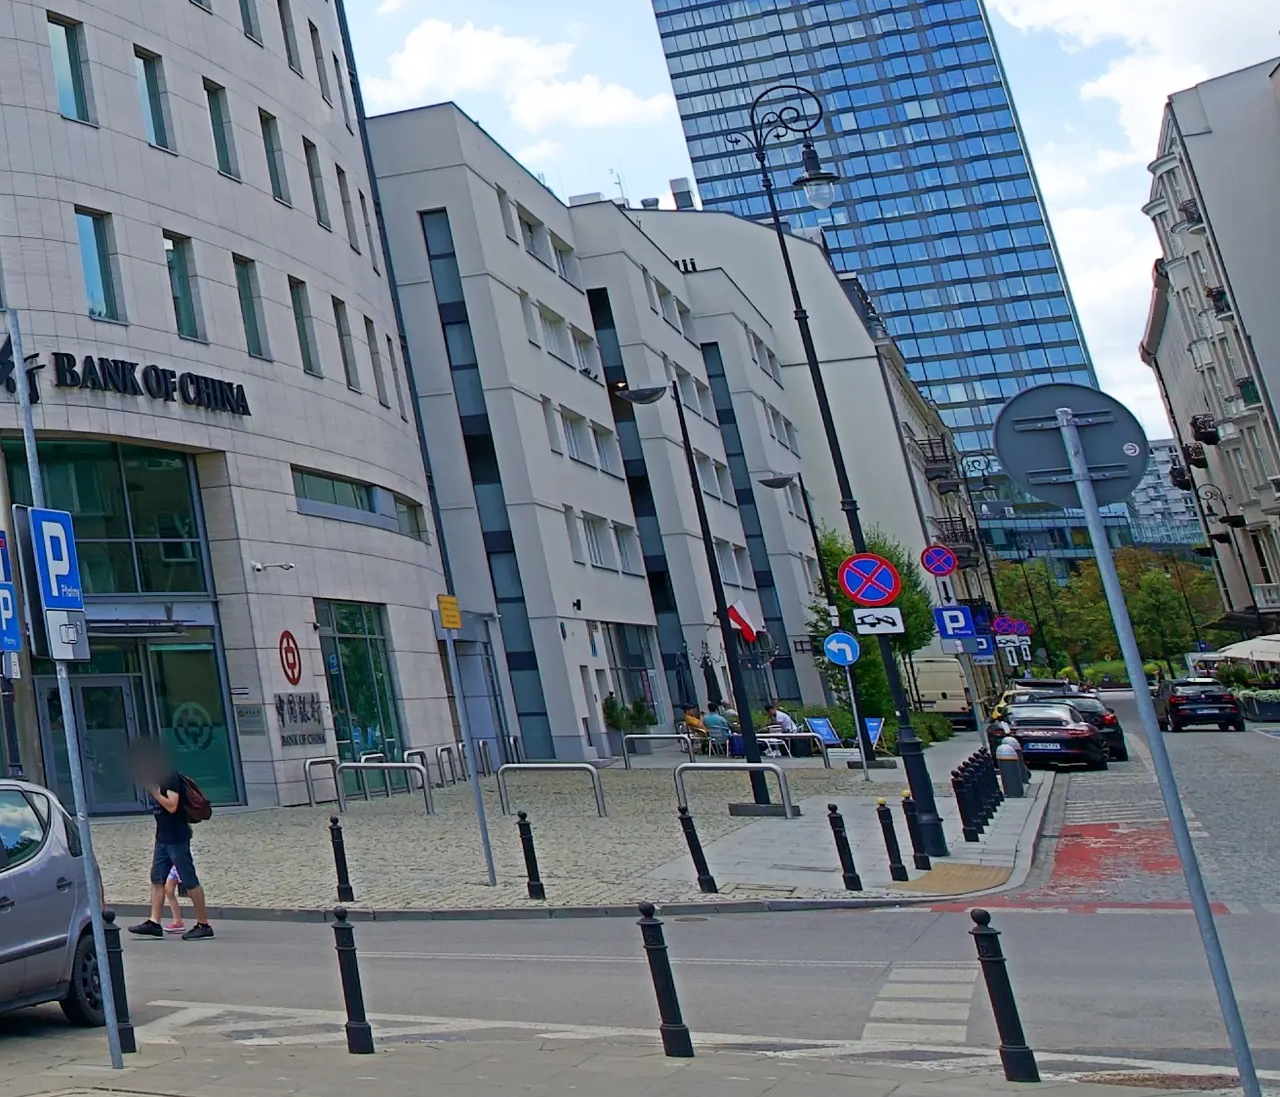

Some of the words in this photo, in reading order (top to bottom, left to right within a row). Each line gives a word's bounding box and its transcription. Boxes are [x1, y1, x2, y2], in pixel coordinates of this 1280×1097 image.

[51, 352, 144, 396] BANK
[143, 364, 177, 402] OF
[178, 372, 252, 417] CHINA
[42, 521, 69, 597] P
[943, 610, 966, 634] P
